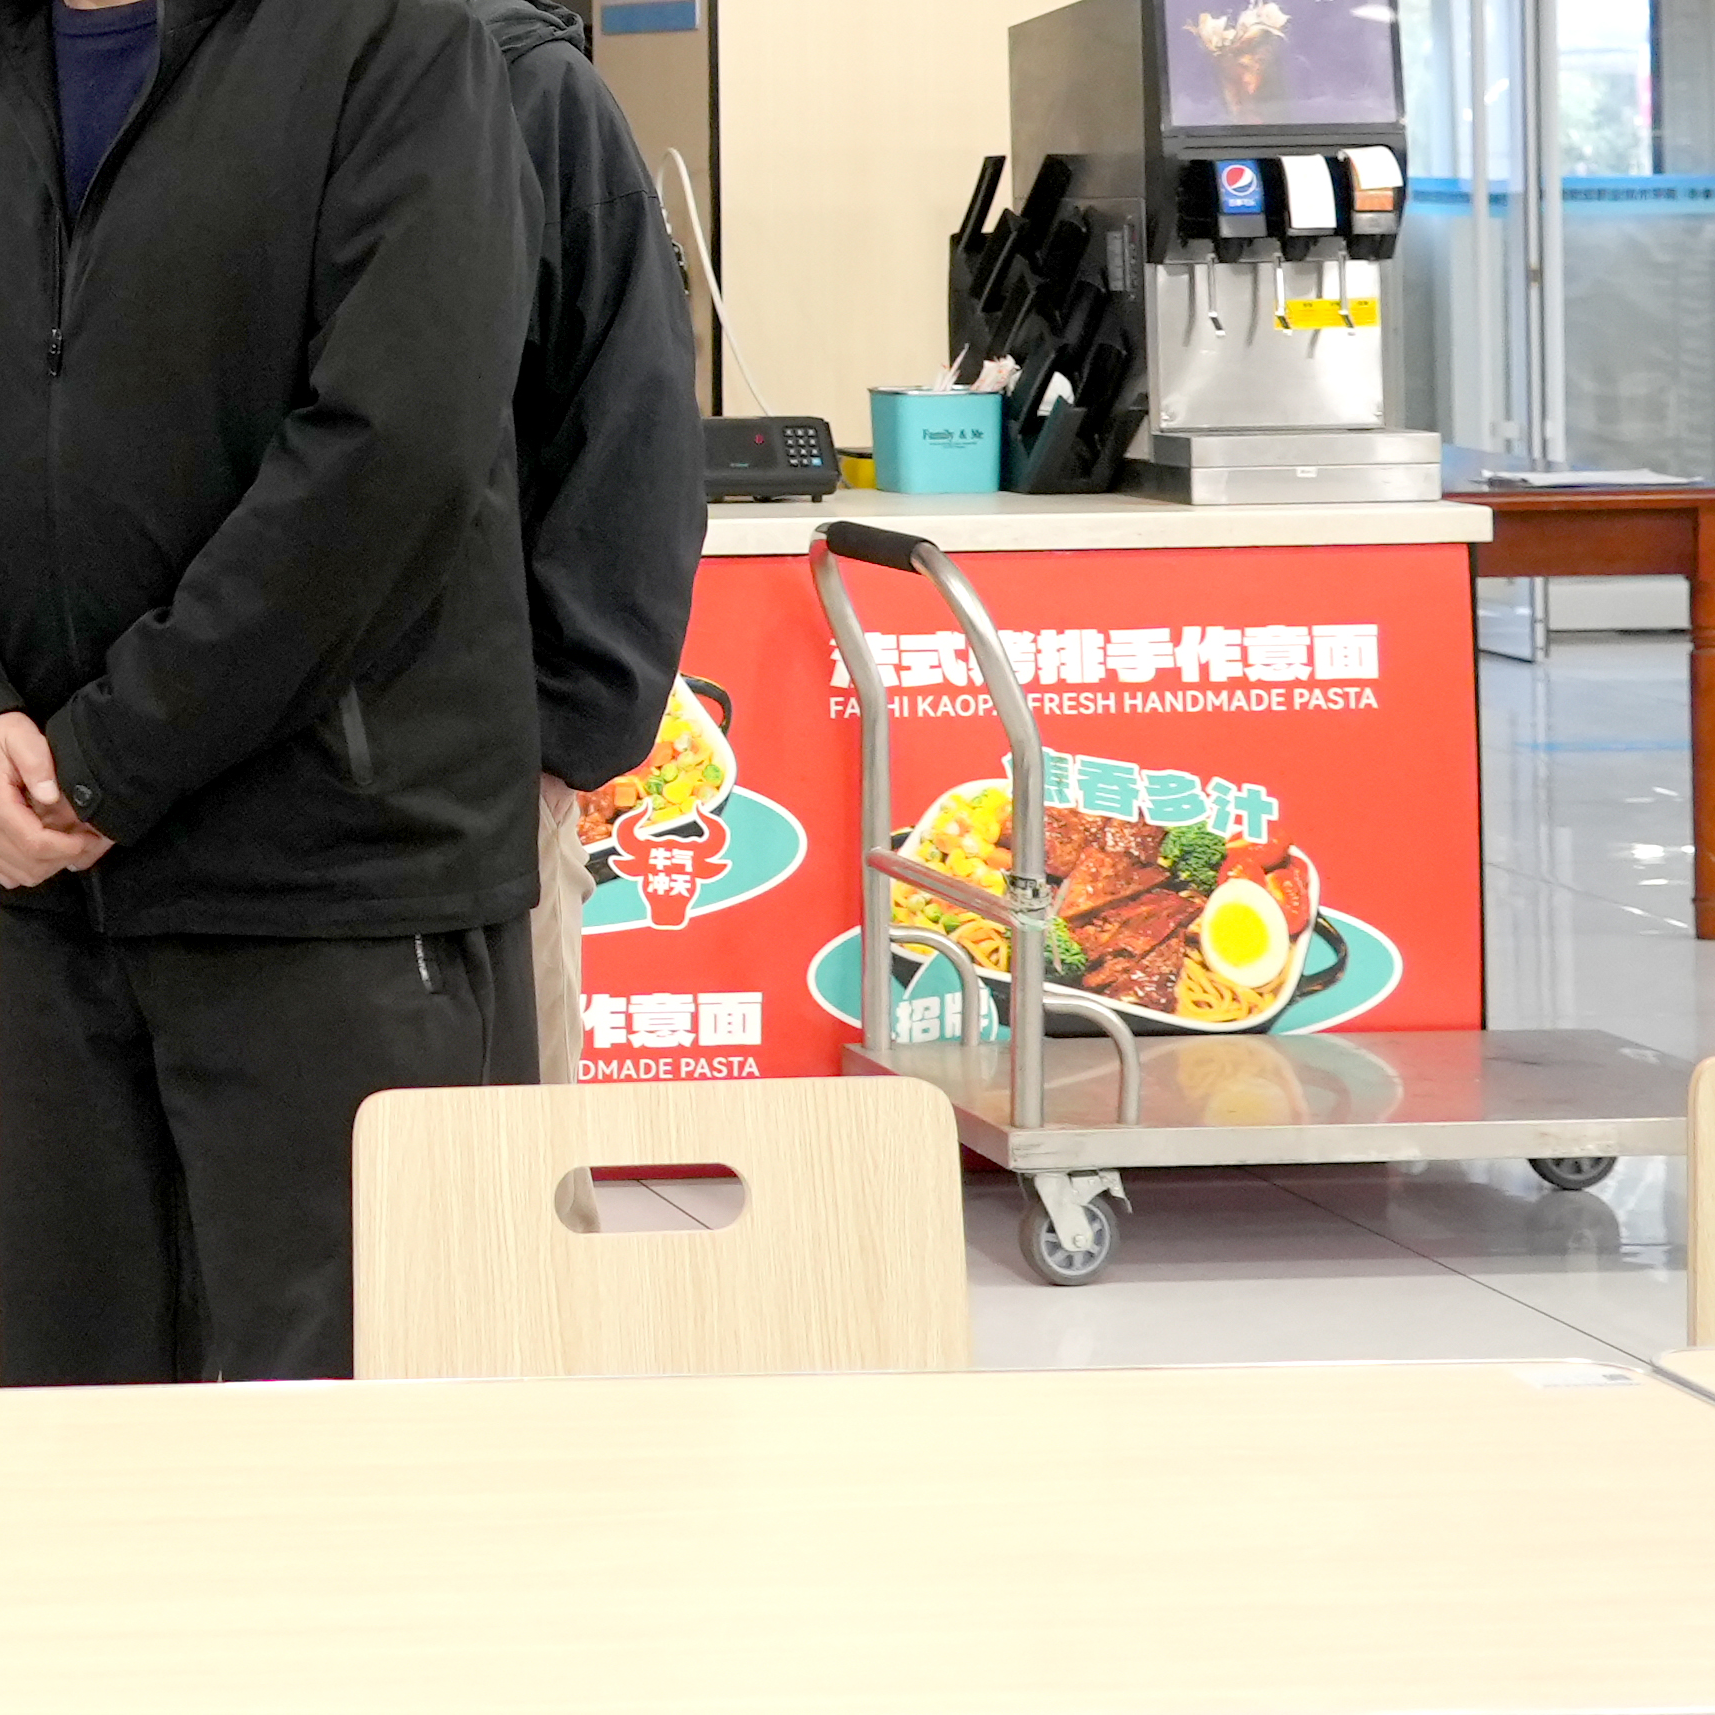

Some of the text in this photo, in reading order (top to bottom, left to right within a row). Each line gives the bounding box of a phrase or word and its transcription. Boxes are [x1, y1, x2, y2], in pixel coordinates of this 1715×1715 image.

[830, 696, 909, 719] FAHI
[1124, 689, 1287, 714] HANDMADE
[1293, 687, 1379, 711] PASTA
[648, 847, 695, 873] 牛气
[647, 873, 692, 898] 冲天
[578, 1056, 761, 1081] DMADE PASTA
